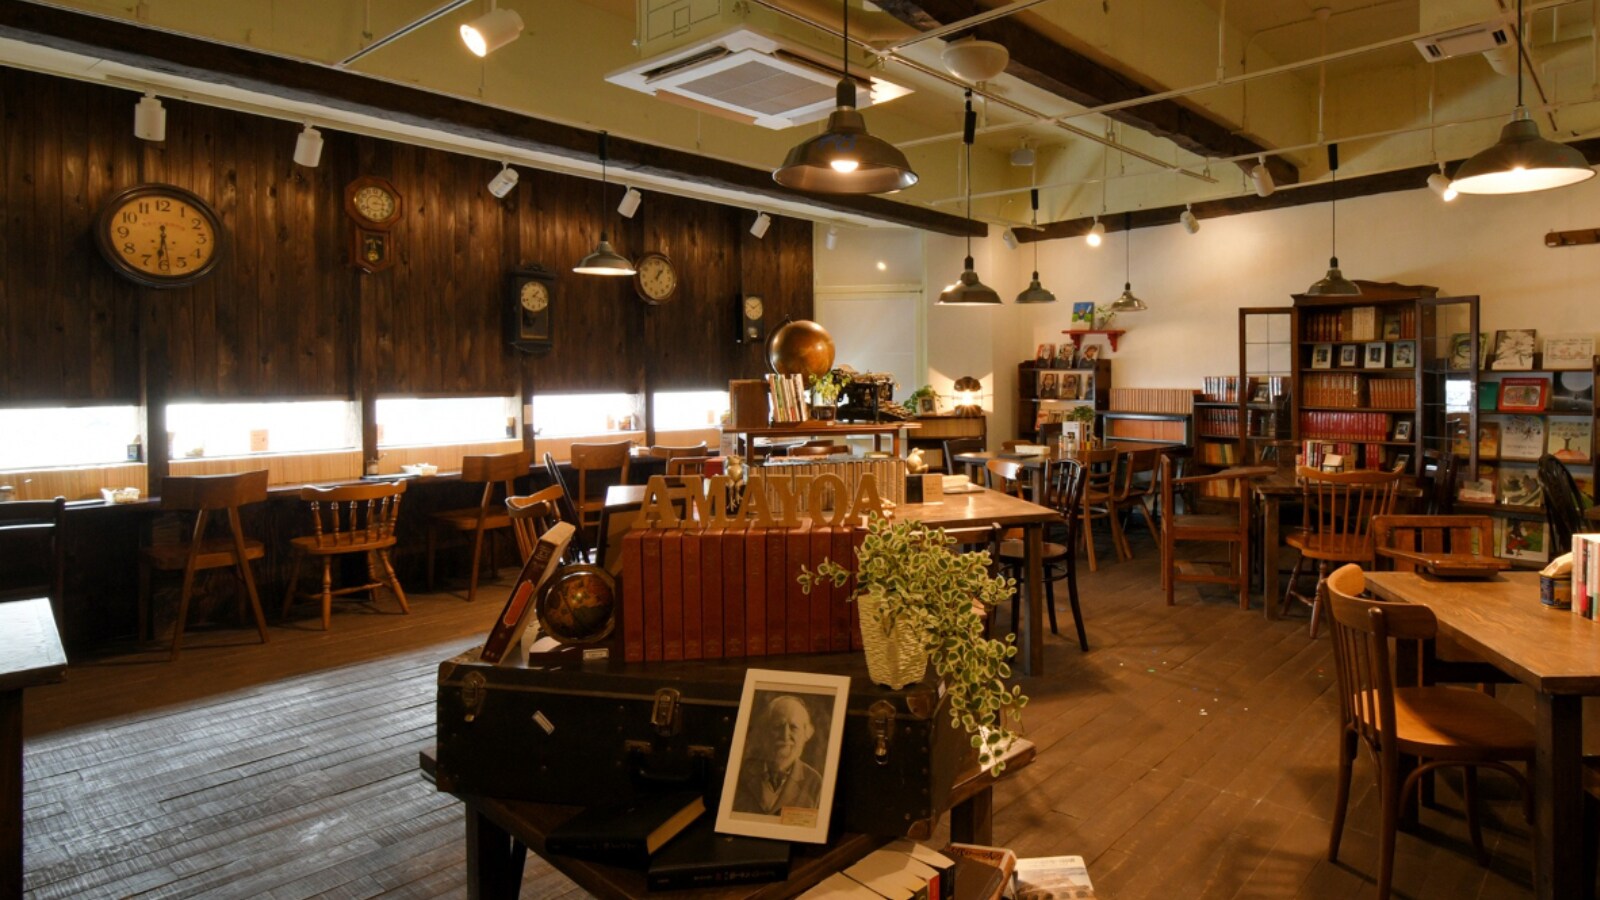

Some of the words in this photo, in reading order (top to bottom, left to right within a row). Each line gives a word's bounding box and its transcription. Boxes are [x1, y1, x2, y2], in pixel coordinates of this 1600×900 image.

[139, 202, 149, 214] 11
[155, 200, 171, 211] 12
[122, 211, 138, 224] 10
[180, 207, 185, 218] 1
[191, 218, 201, 230] 2
[117, 226, 130, 238] 9
[196, 233, 207, 244] 3
[123, 242, 136, 254] 8
[141, 254, 152, 266] 7
[176, 256, 187, 268] 5
